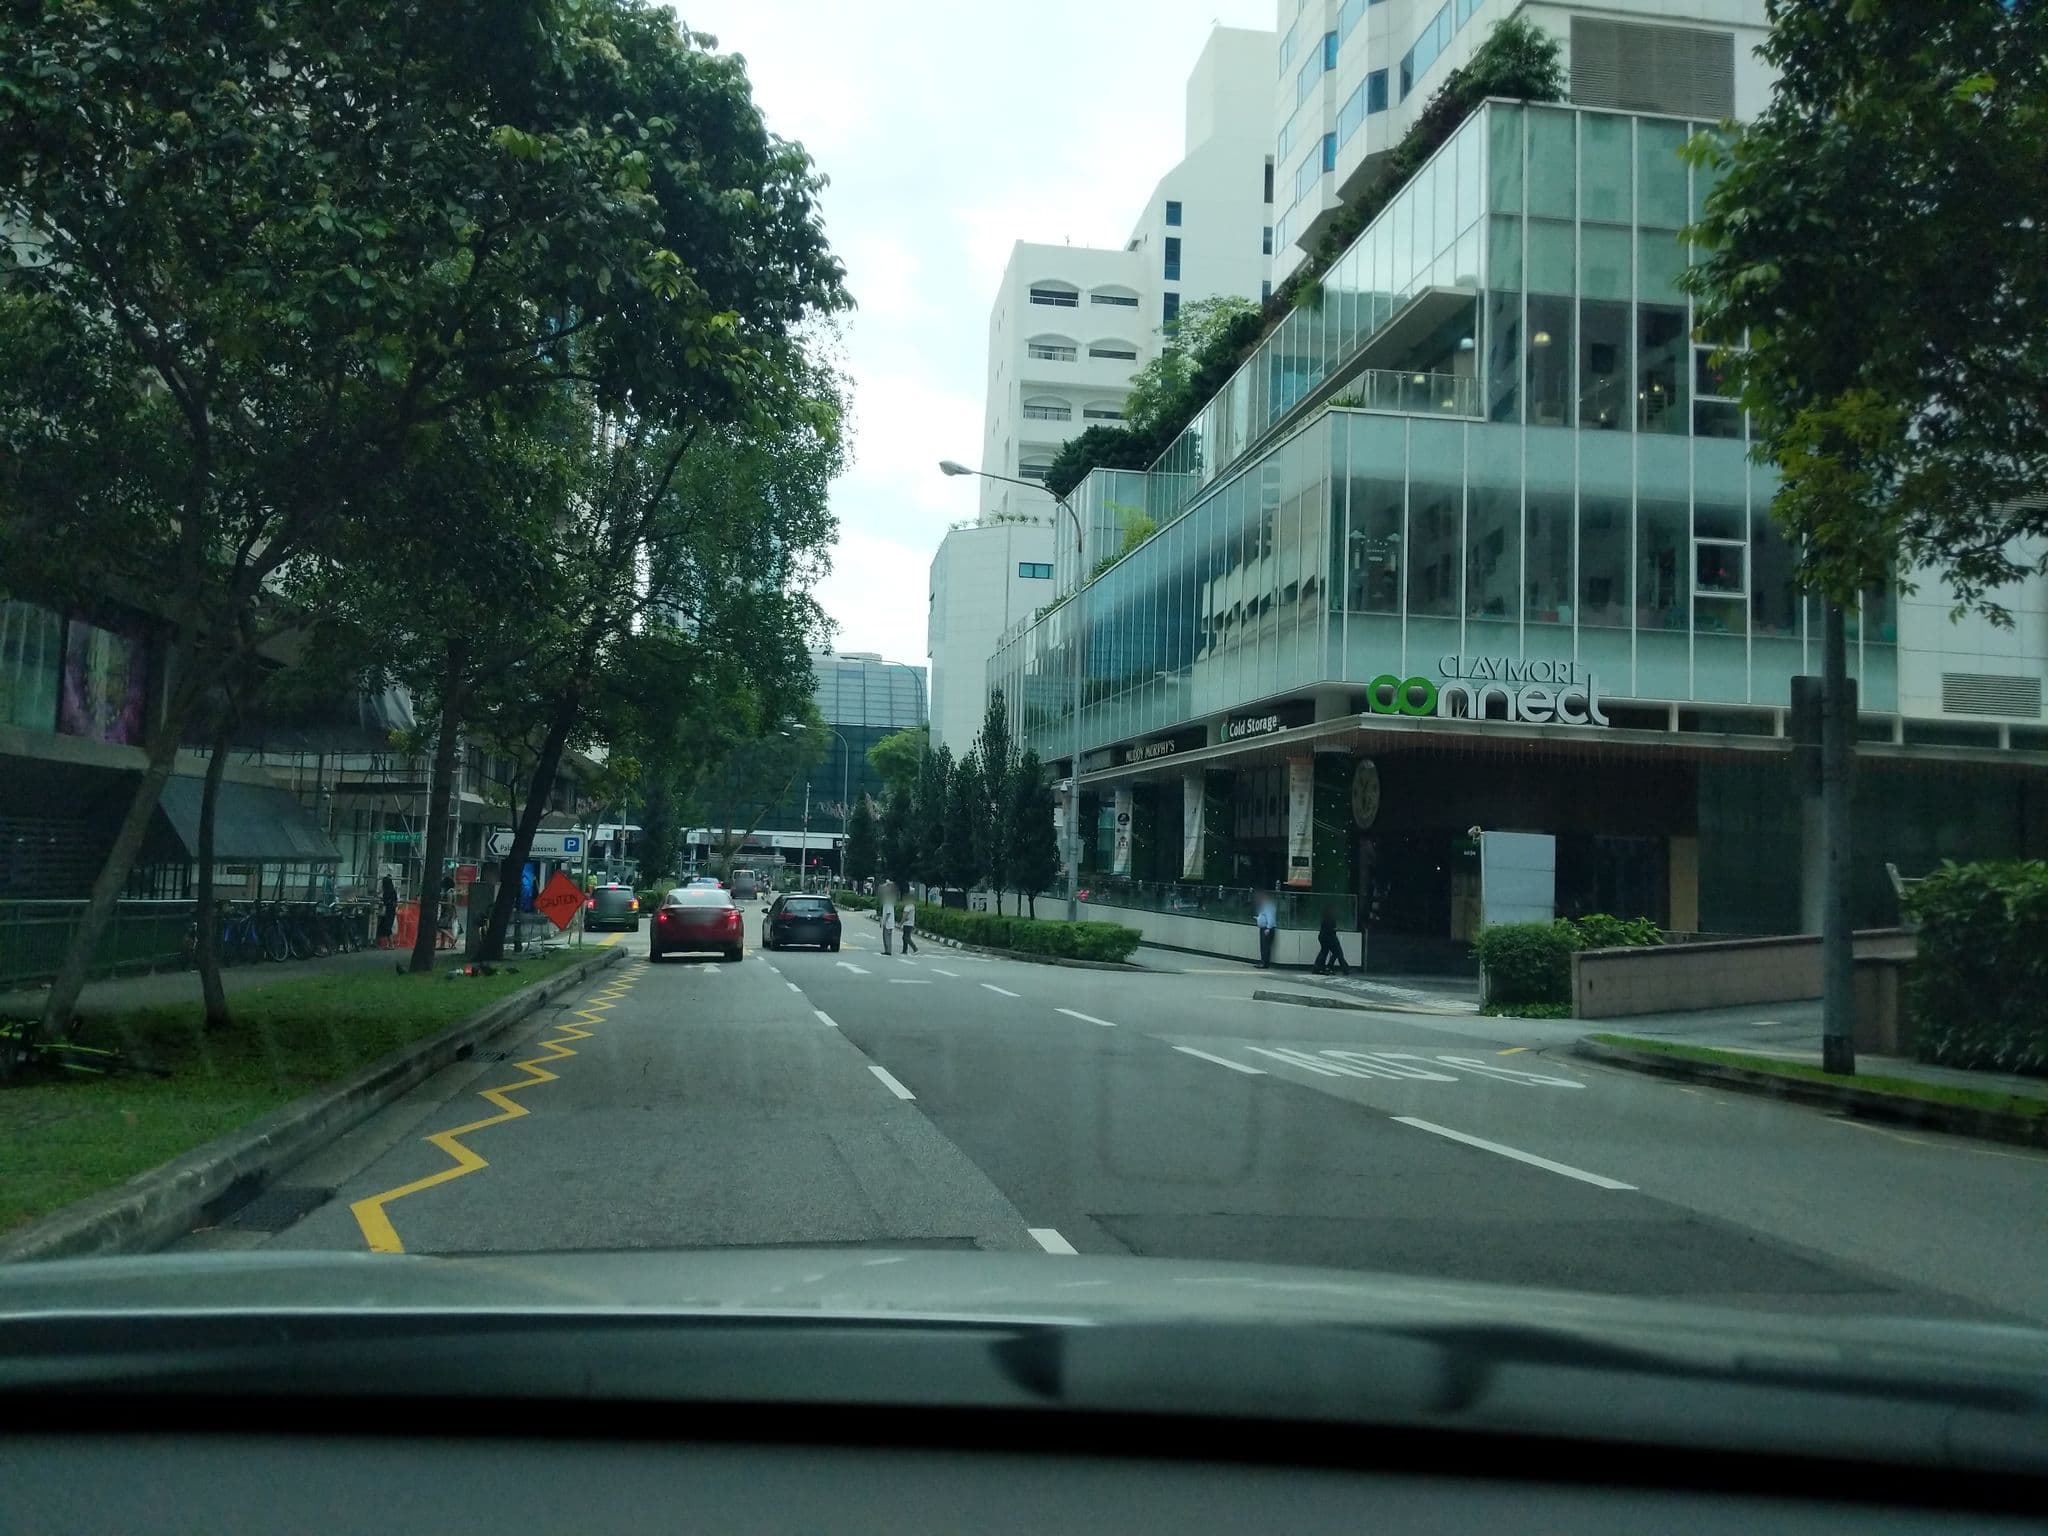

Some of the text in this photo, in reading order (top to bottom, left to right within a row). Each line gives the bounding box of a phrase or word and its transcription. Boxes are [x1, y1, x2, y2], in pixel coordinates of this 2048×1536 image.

[1438, 655, 1584, 685] CLAYMORE
[1229, 715, 1278, 738] Cold Storage
[541, 894, 578, 908] CAUTION
